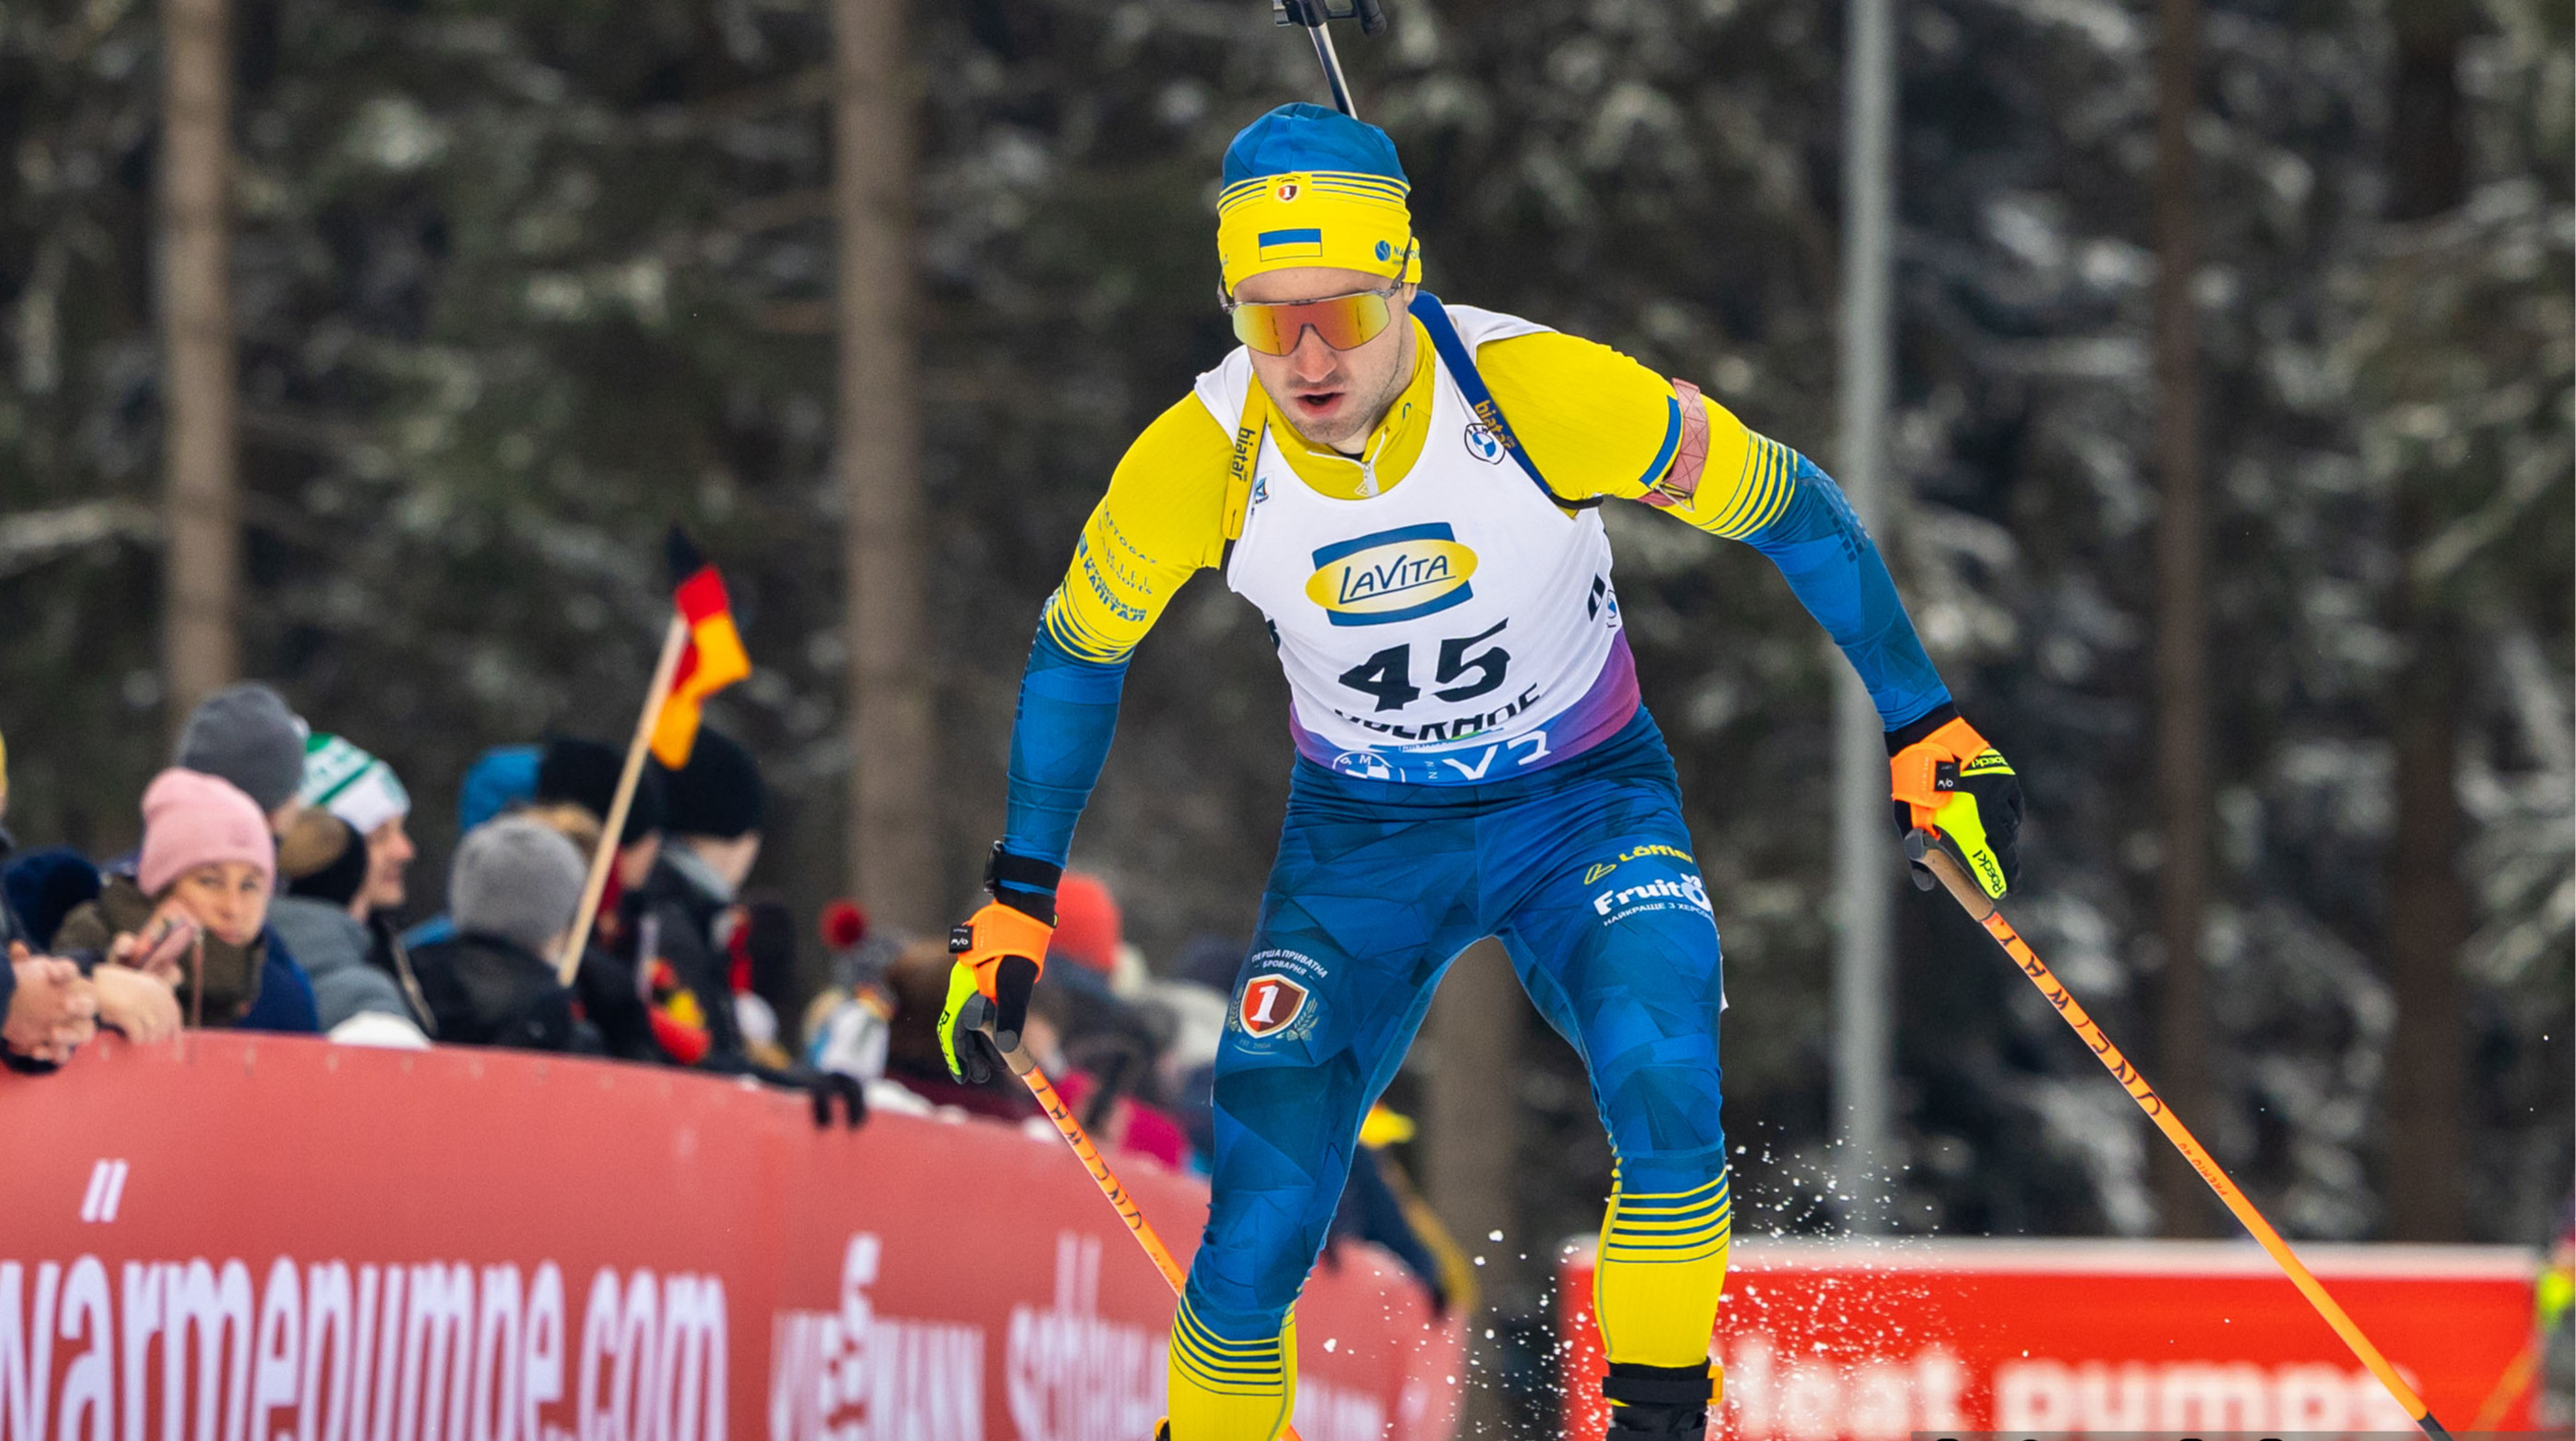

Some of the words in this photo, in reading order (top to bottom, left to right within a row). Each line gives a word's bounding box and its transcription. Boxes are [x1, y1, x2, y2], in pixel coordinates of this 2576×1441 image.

[1230, 426, 1256, 481] biatar
[1337, 617, 1510, 713] 45
[1972, 849, 2003, 894] Roeckl
[1604, 902, 1666, 927] НАЙКРАЩЕ
[1251, 949, 1281, 963] ПЕРША
[1281, 949, 1328, 979] ПРИВАТНА
[1263, 959, 1308, 976] БРОВАРНЯ
[1249, 984, 1279, 1024] 1
